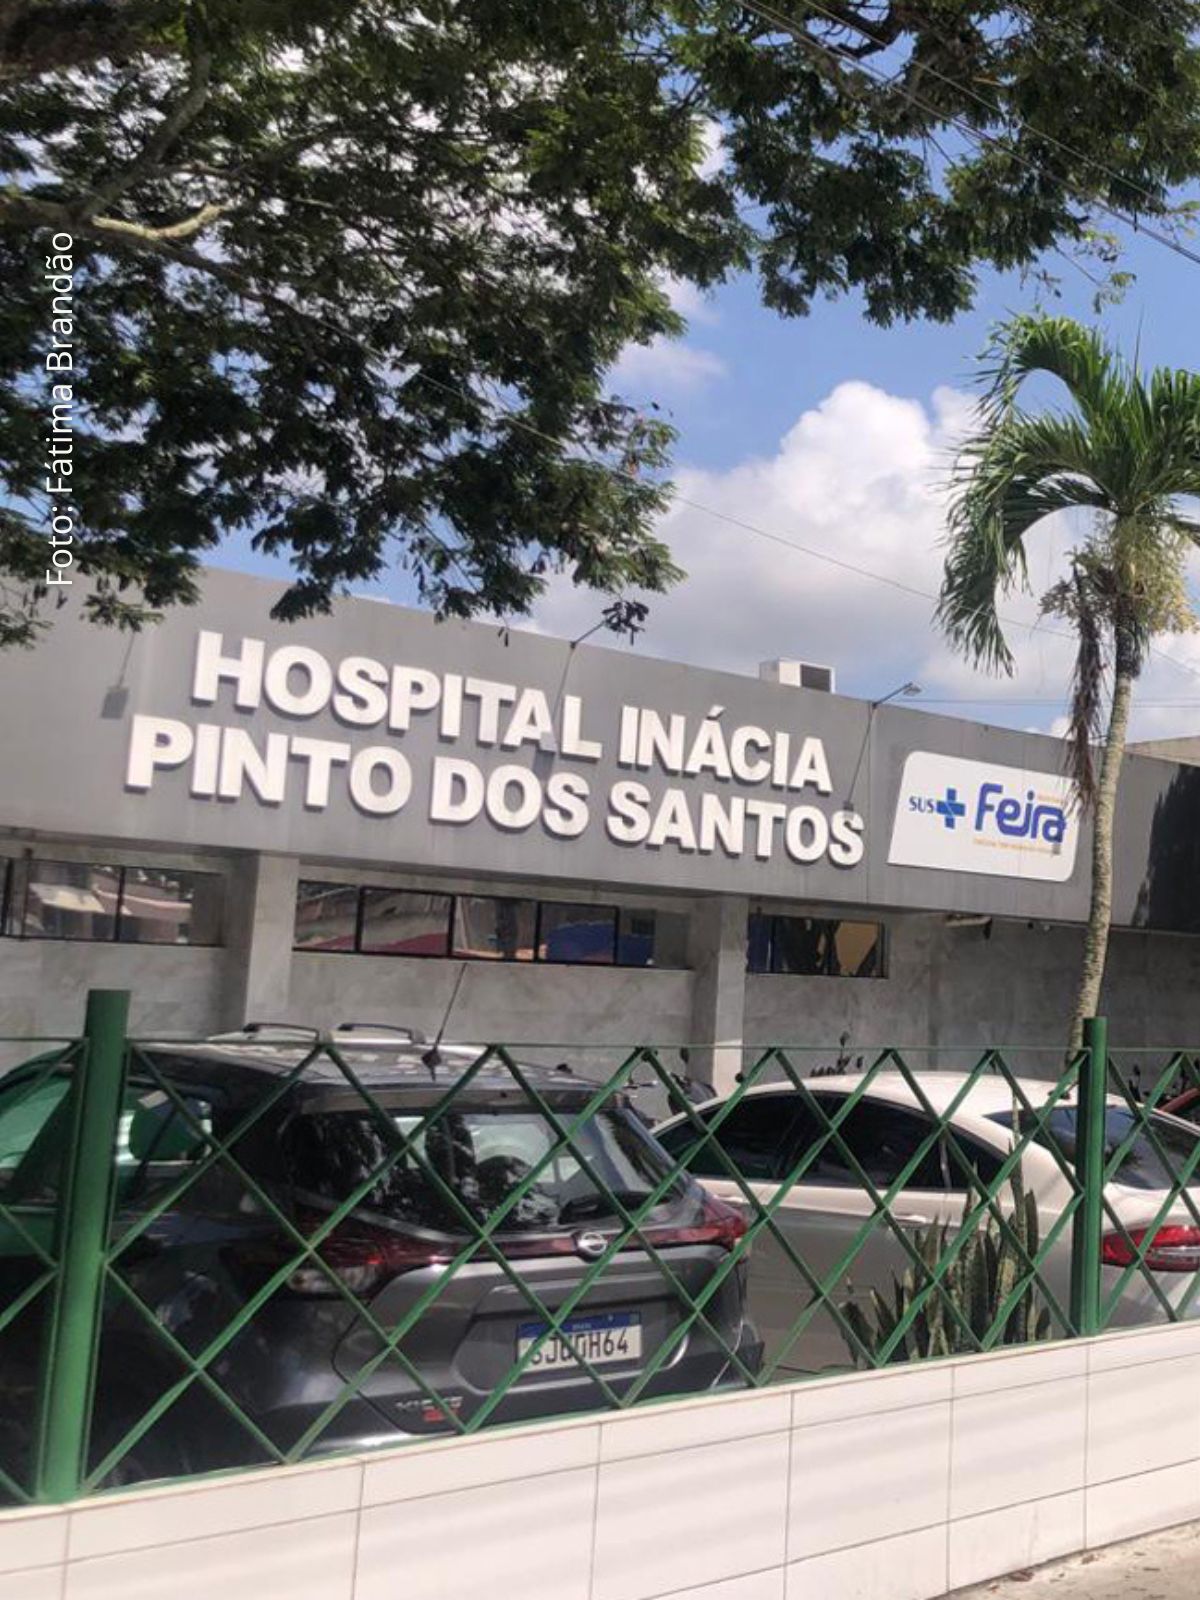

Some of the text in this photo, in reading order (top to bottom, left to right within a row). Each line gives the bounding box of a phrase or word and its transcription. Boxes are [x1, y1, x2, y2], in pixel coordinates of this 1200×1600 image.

[192, 629, 833, 793] HOSPITAL INÁCIA
[125, 713, 865, 866] PINTO DOS SANTOS
[908, 795, 934, 814] SUS
[975, 782, 1067, 843] Feira
